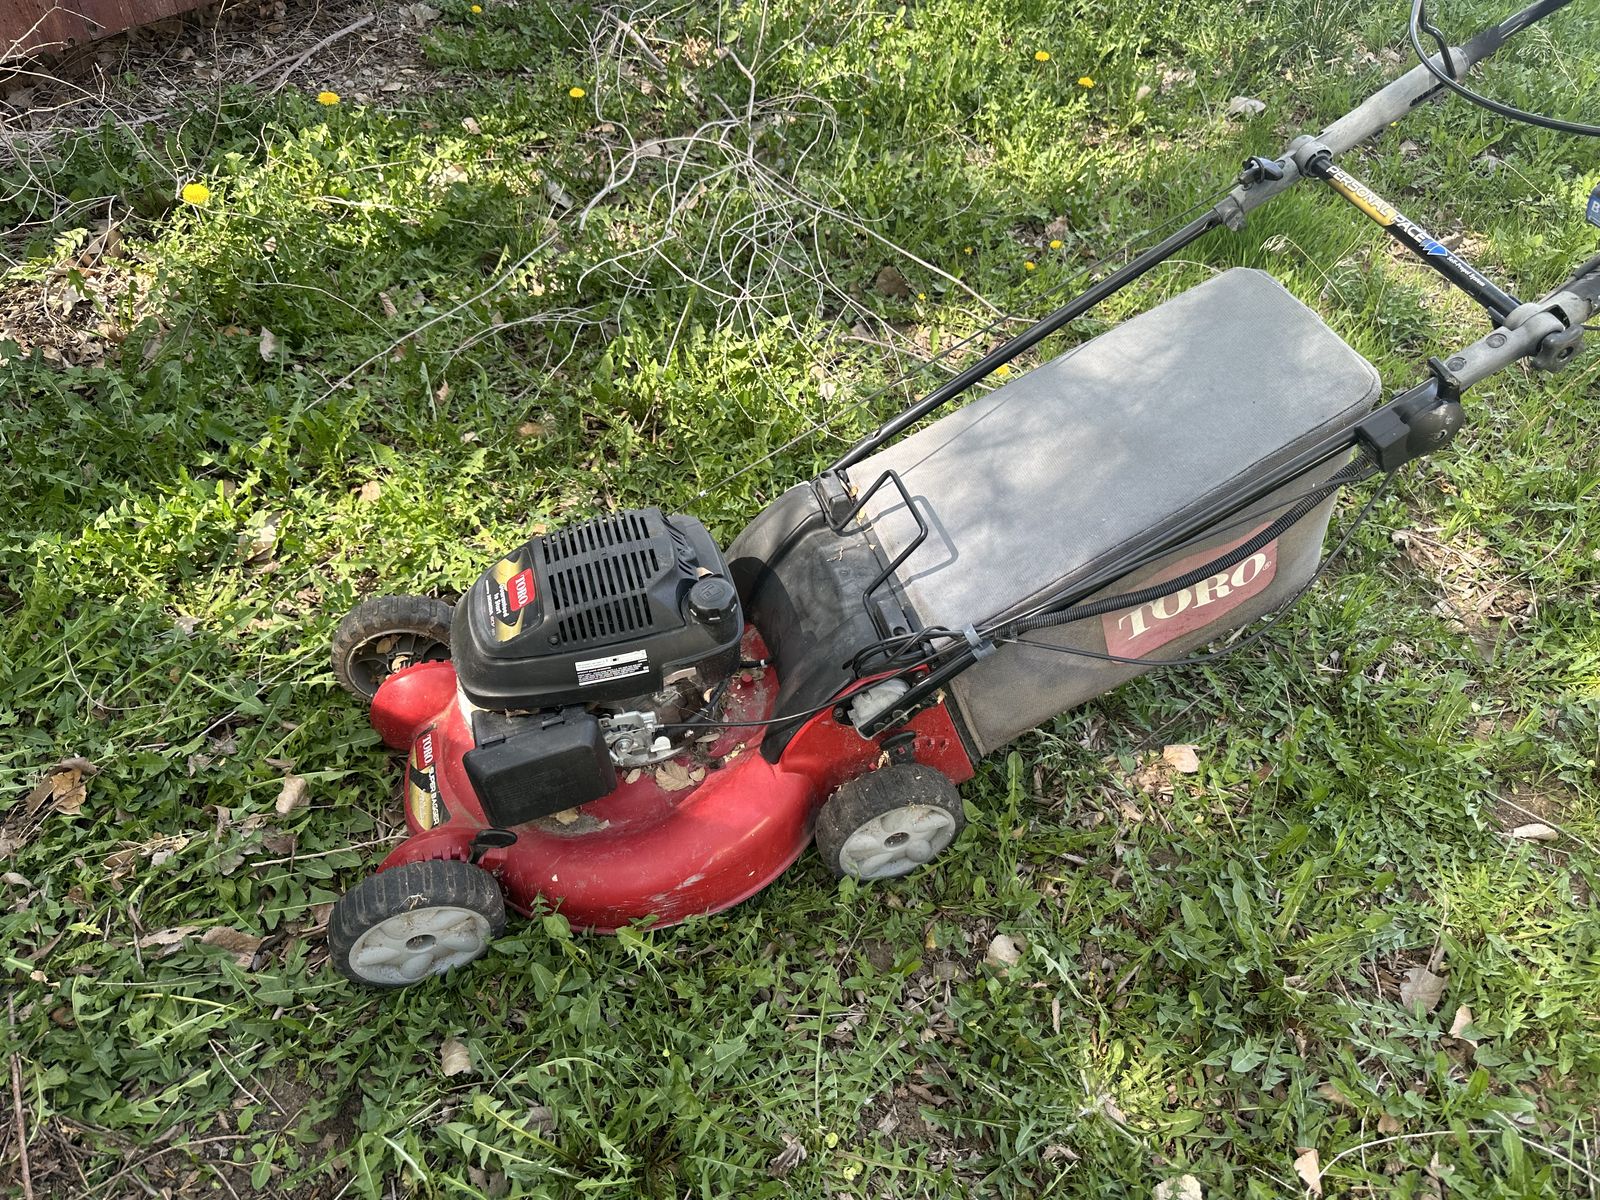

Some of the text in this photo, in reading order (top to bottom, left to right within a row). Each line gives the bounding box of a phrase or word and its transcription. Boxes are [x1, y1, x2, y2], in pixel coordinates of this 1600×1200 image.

[1326, 165, 1428, 243] PERSONAL PACE
[1468, 271, 1486, 288] System
[514, 574, 529, 606] TORO
[422, 733, 434, 764] TORO
[428, 765, 440, 826] SUPER BAGGER
